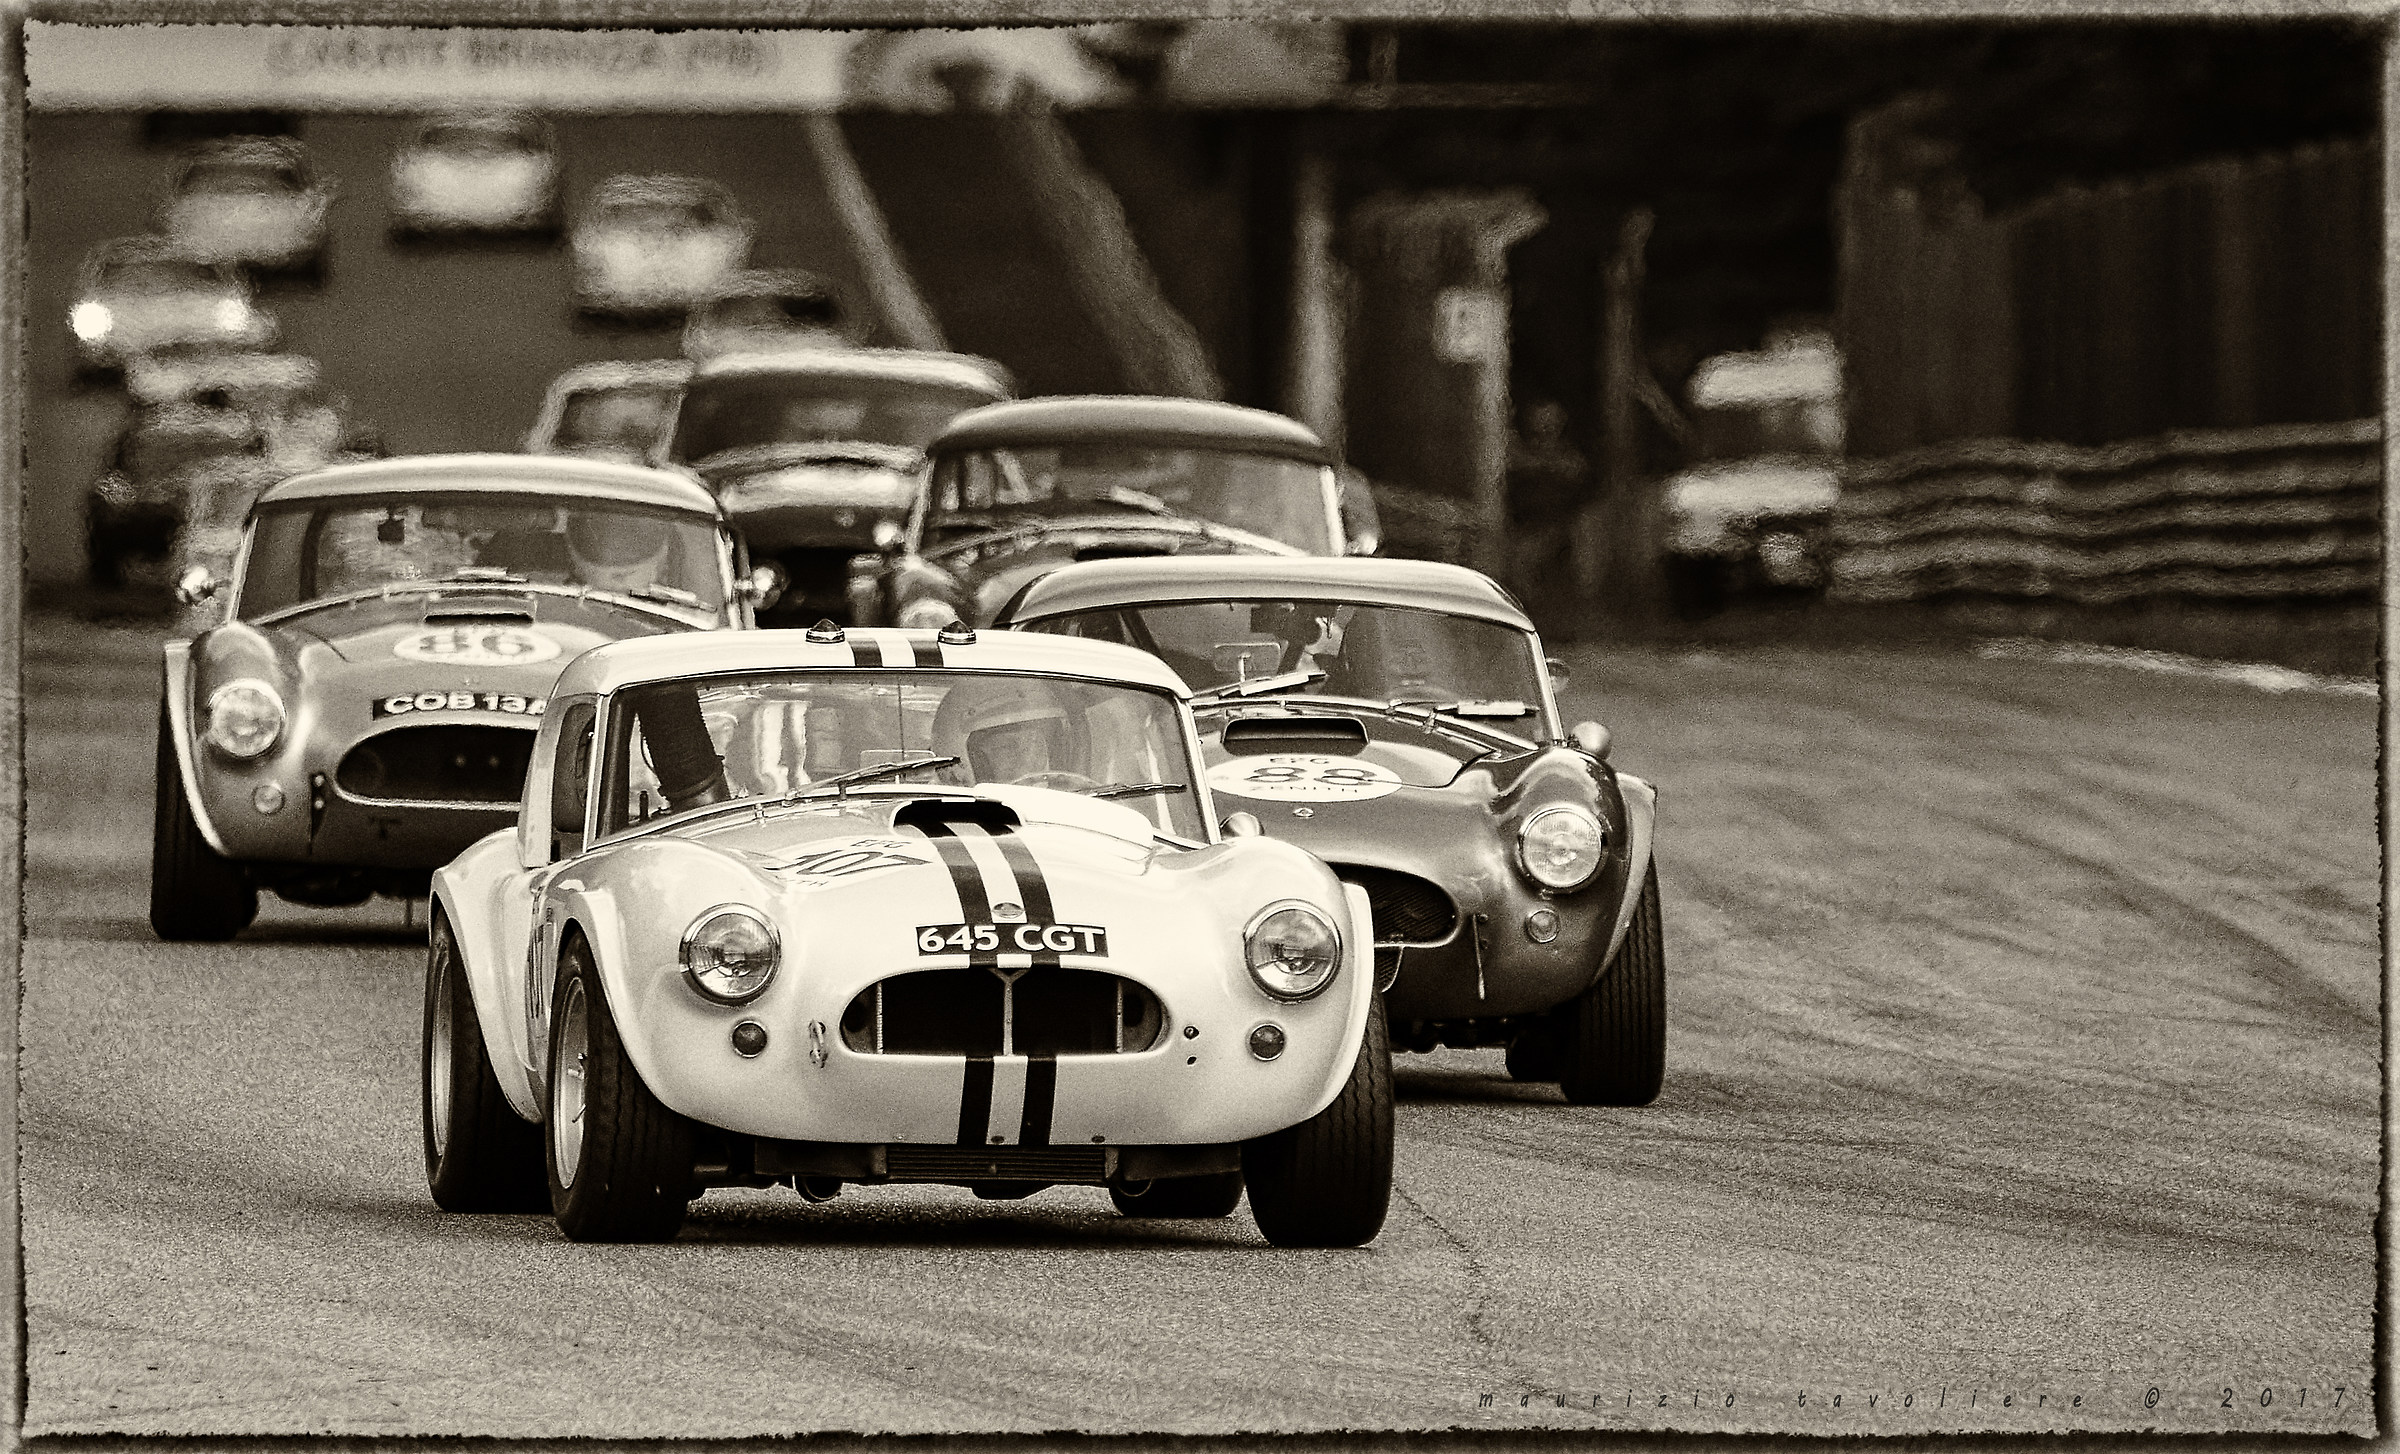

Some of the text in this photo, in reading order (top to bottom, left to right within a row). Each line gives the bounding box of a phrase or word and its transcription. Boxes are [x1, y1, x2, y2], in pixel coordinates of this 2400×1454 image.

[418, 630, 538, 654] 86
[383, 691, 477, 715] COB
[1243, 766, 1378, 786] 88
[763, 849, 933, 877] 107
[918, 925, 1106, 953] 645 CGT
